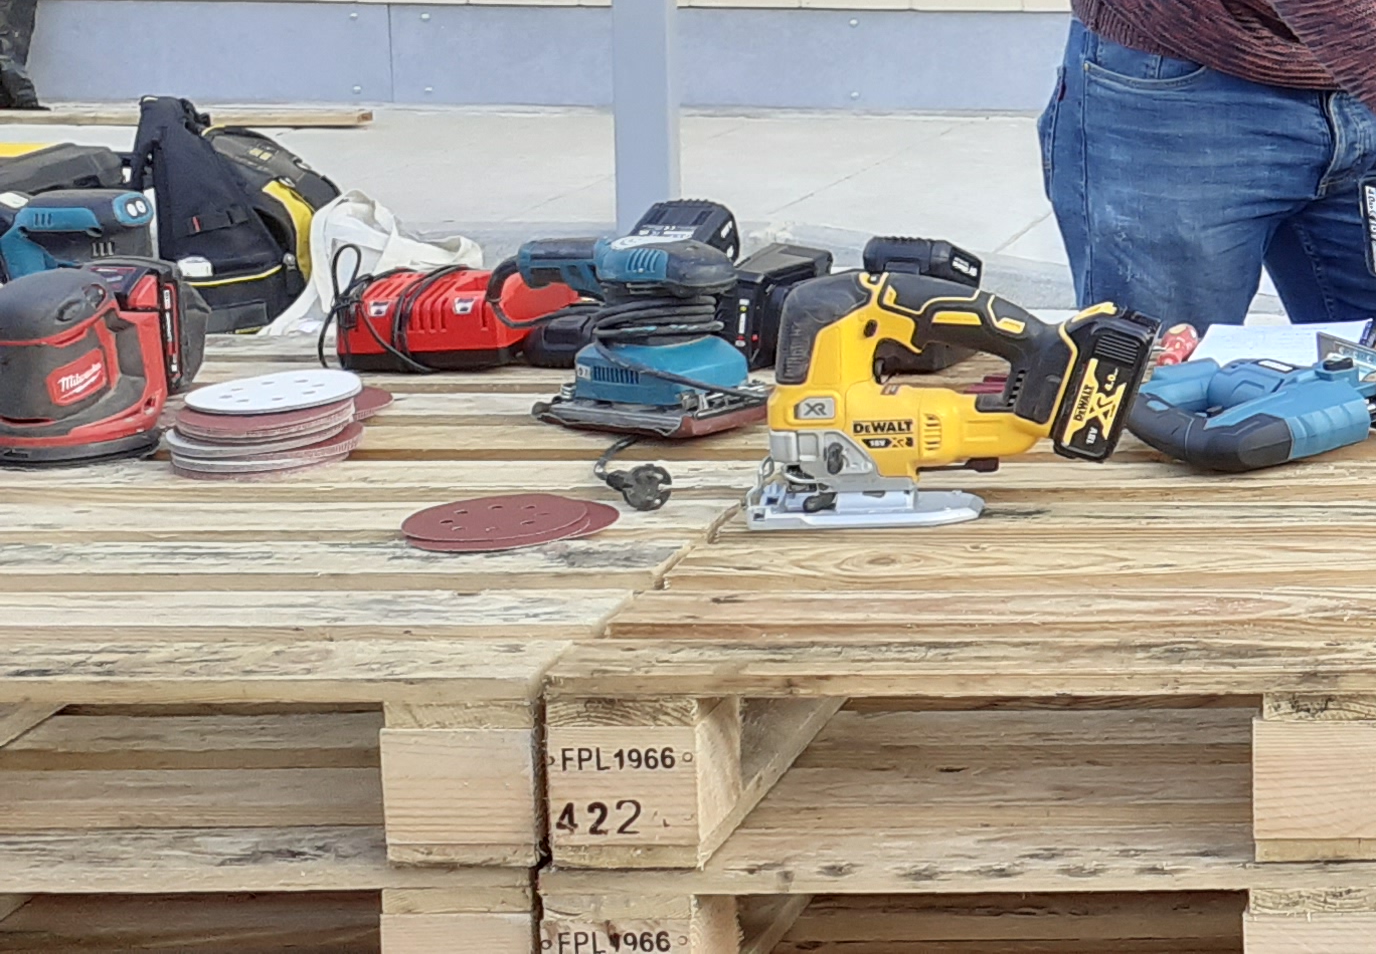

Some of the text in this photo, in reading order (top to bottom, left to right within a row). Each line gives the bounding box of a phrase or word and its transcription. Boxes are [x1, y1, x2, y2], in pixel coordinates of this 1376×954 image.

[803, 402, 828, 417] XR
[561, 746, 676, 772] FPL1966
[555, 799, 642, 836] 422
